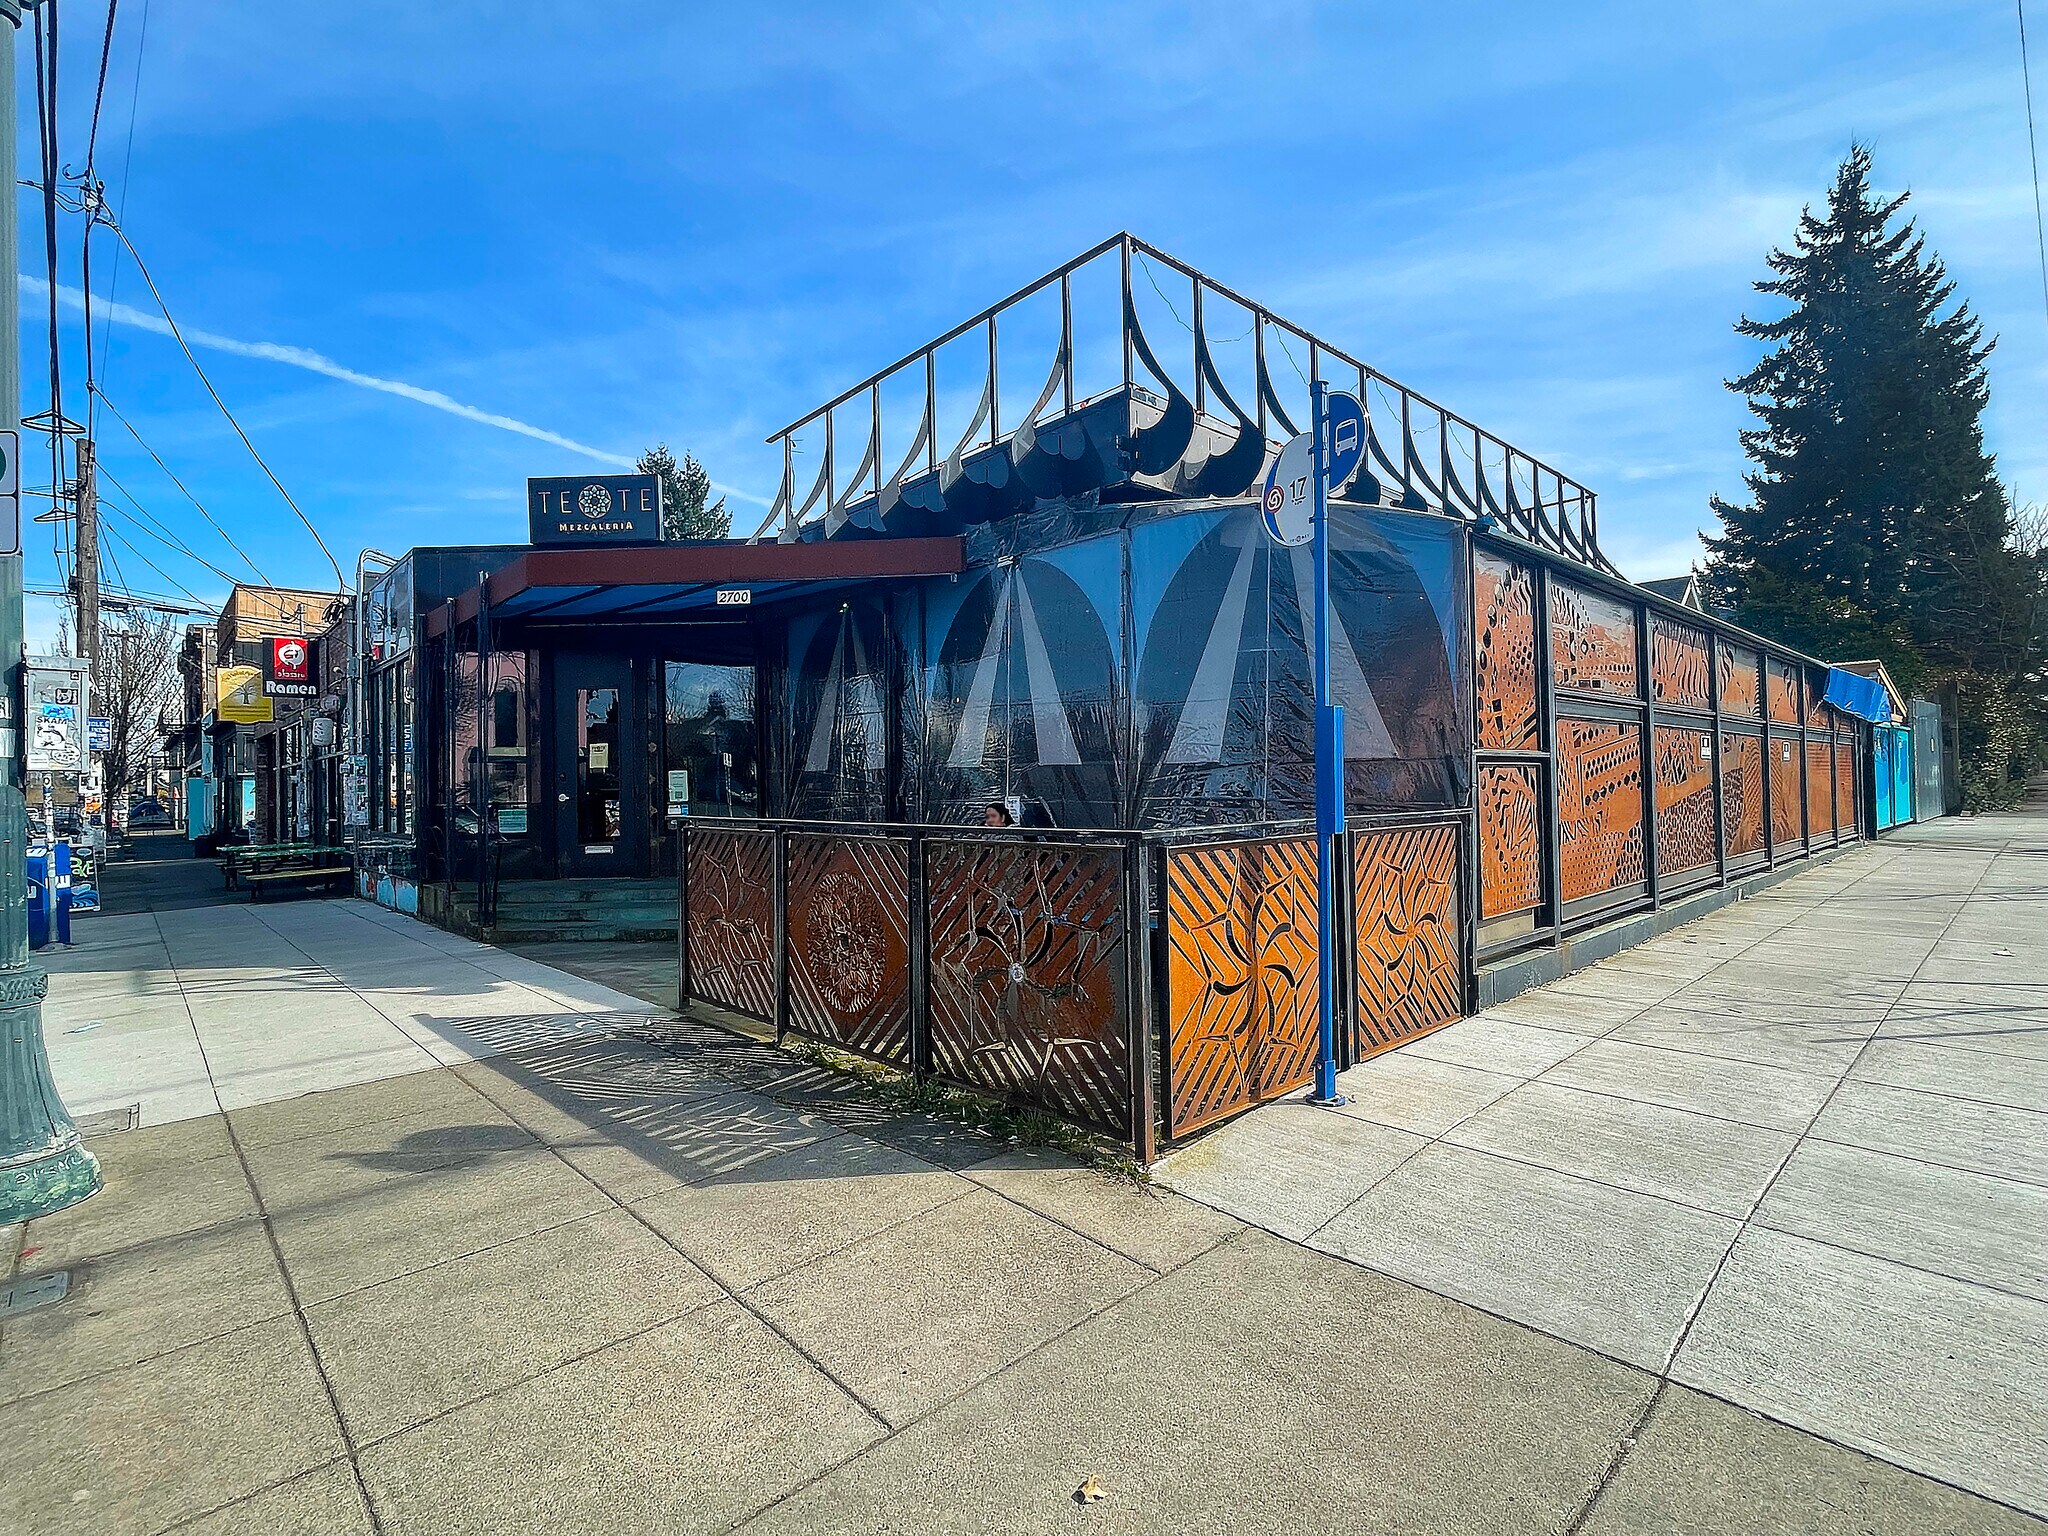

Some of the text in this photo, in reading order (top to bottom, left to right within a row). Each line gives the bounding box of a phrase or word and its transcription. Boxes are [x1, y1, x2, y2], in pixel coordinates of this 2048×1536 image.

[1290, 476, 1308, 498] 17
[559, 521, 633, 532] MEZCALERIA
[719, 591, 749, 603] 2700
[265, 680, 317, 695] Ramen
